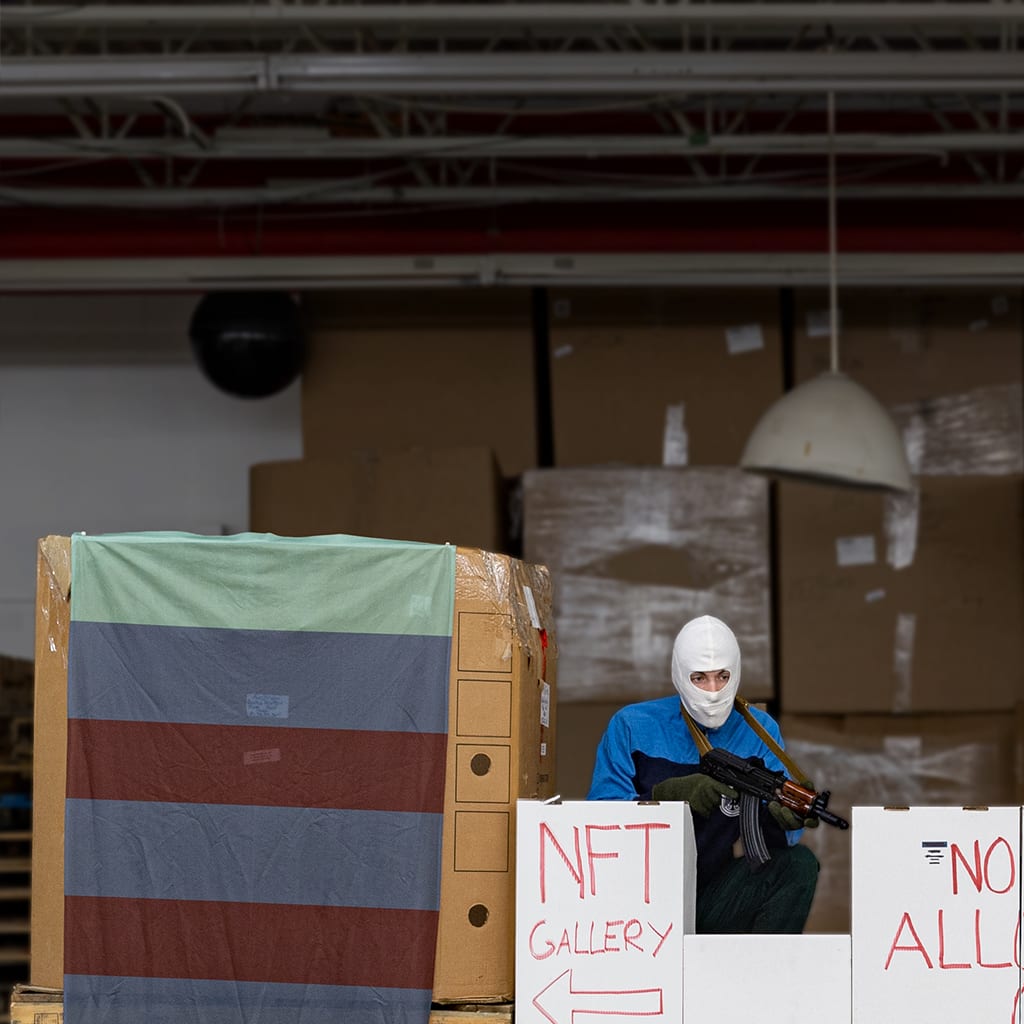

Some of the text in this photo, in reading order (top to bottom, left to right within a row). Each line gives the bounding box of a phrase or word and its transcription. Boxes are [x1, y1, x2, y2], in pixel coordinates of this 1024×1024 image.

[539, 822, 671, 904] NFT
[949, 836, 1017, 895] NO
[528, 919, 674, 961] GALLERY
